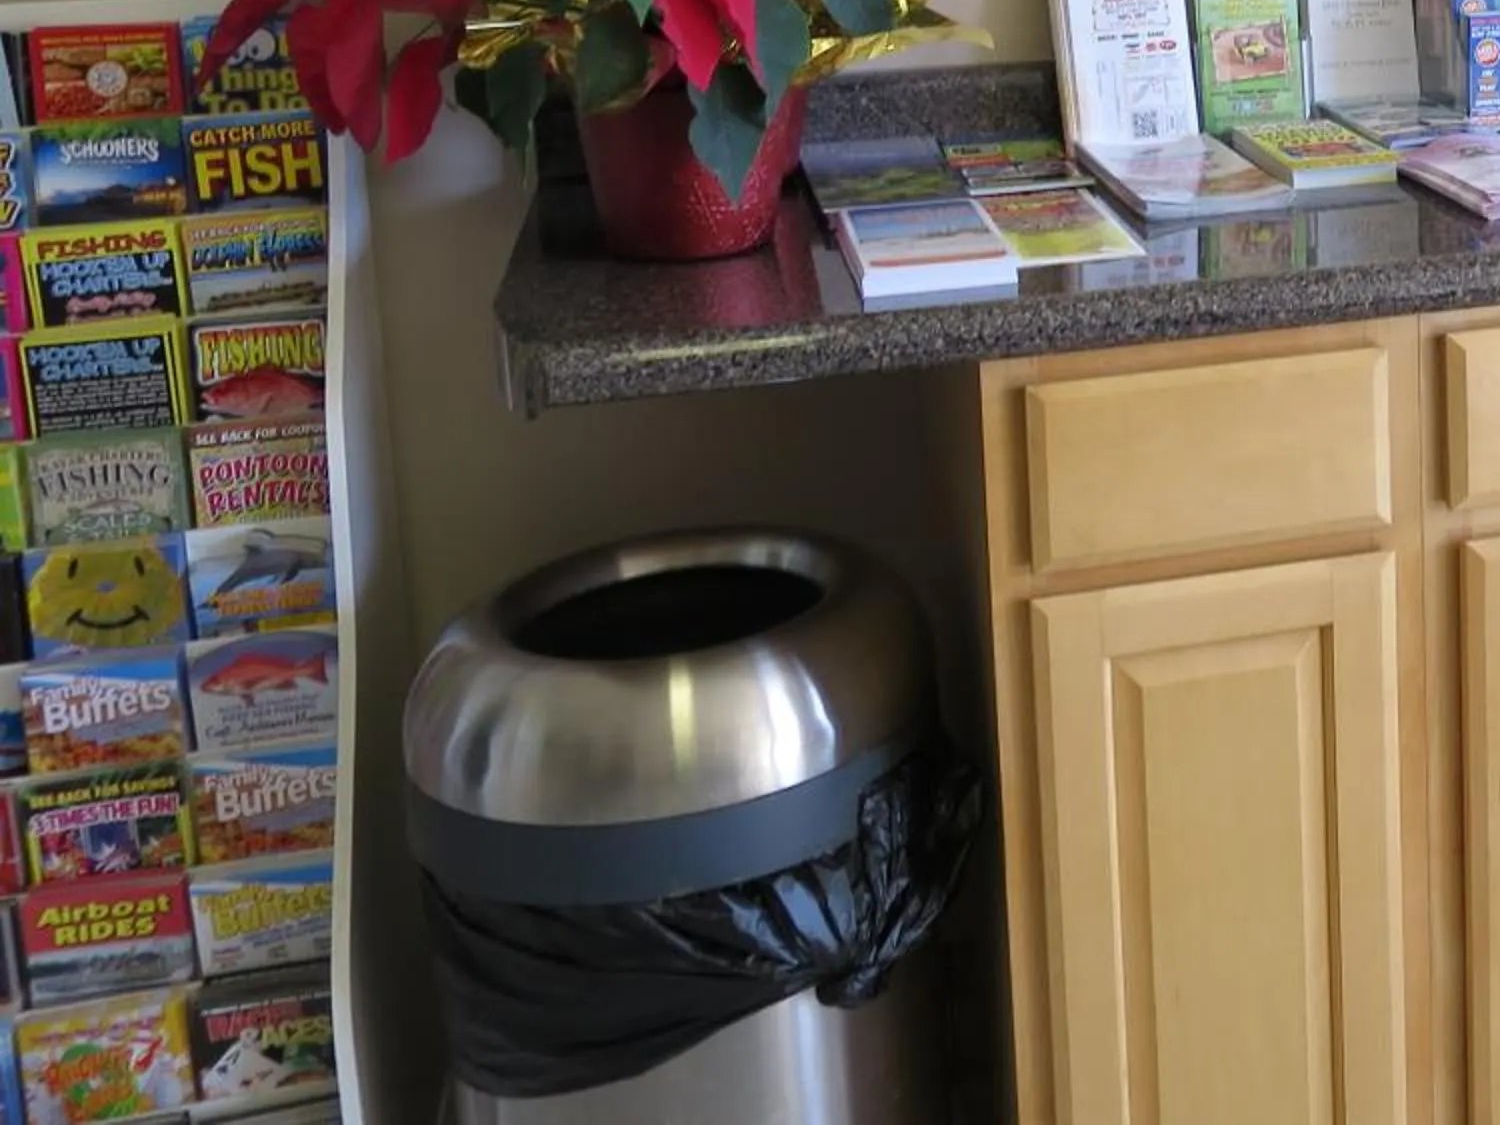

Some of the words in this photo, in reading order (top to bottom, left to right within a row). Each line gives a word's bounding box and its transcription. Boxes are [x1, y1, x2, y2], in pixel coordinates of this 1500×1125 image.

[59, 137, 160, 164] SCHOONERS
[189, 126, 256, 148] CATCH
[261, 120, 317, 141] MORE
[193, 140, 324, 203] FISH
[37, 229, 167, 260] FISHING
[198, 322, 324, 382] FISHING
[36, 461, 170, 497] FISHING
[43, 681, 171, 735] Buffets
[101, 800, 134, 818] THE
[137, 792, 179, 816] FUN!
[215, 771, 337, 822] Buffets
[37, 894, 173, 927] Airboat
[54, 918, 157, 948] RIDES
